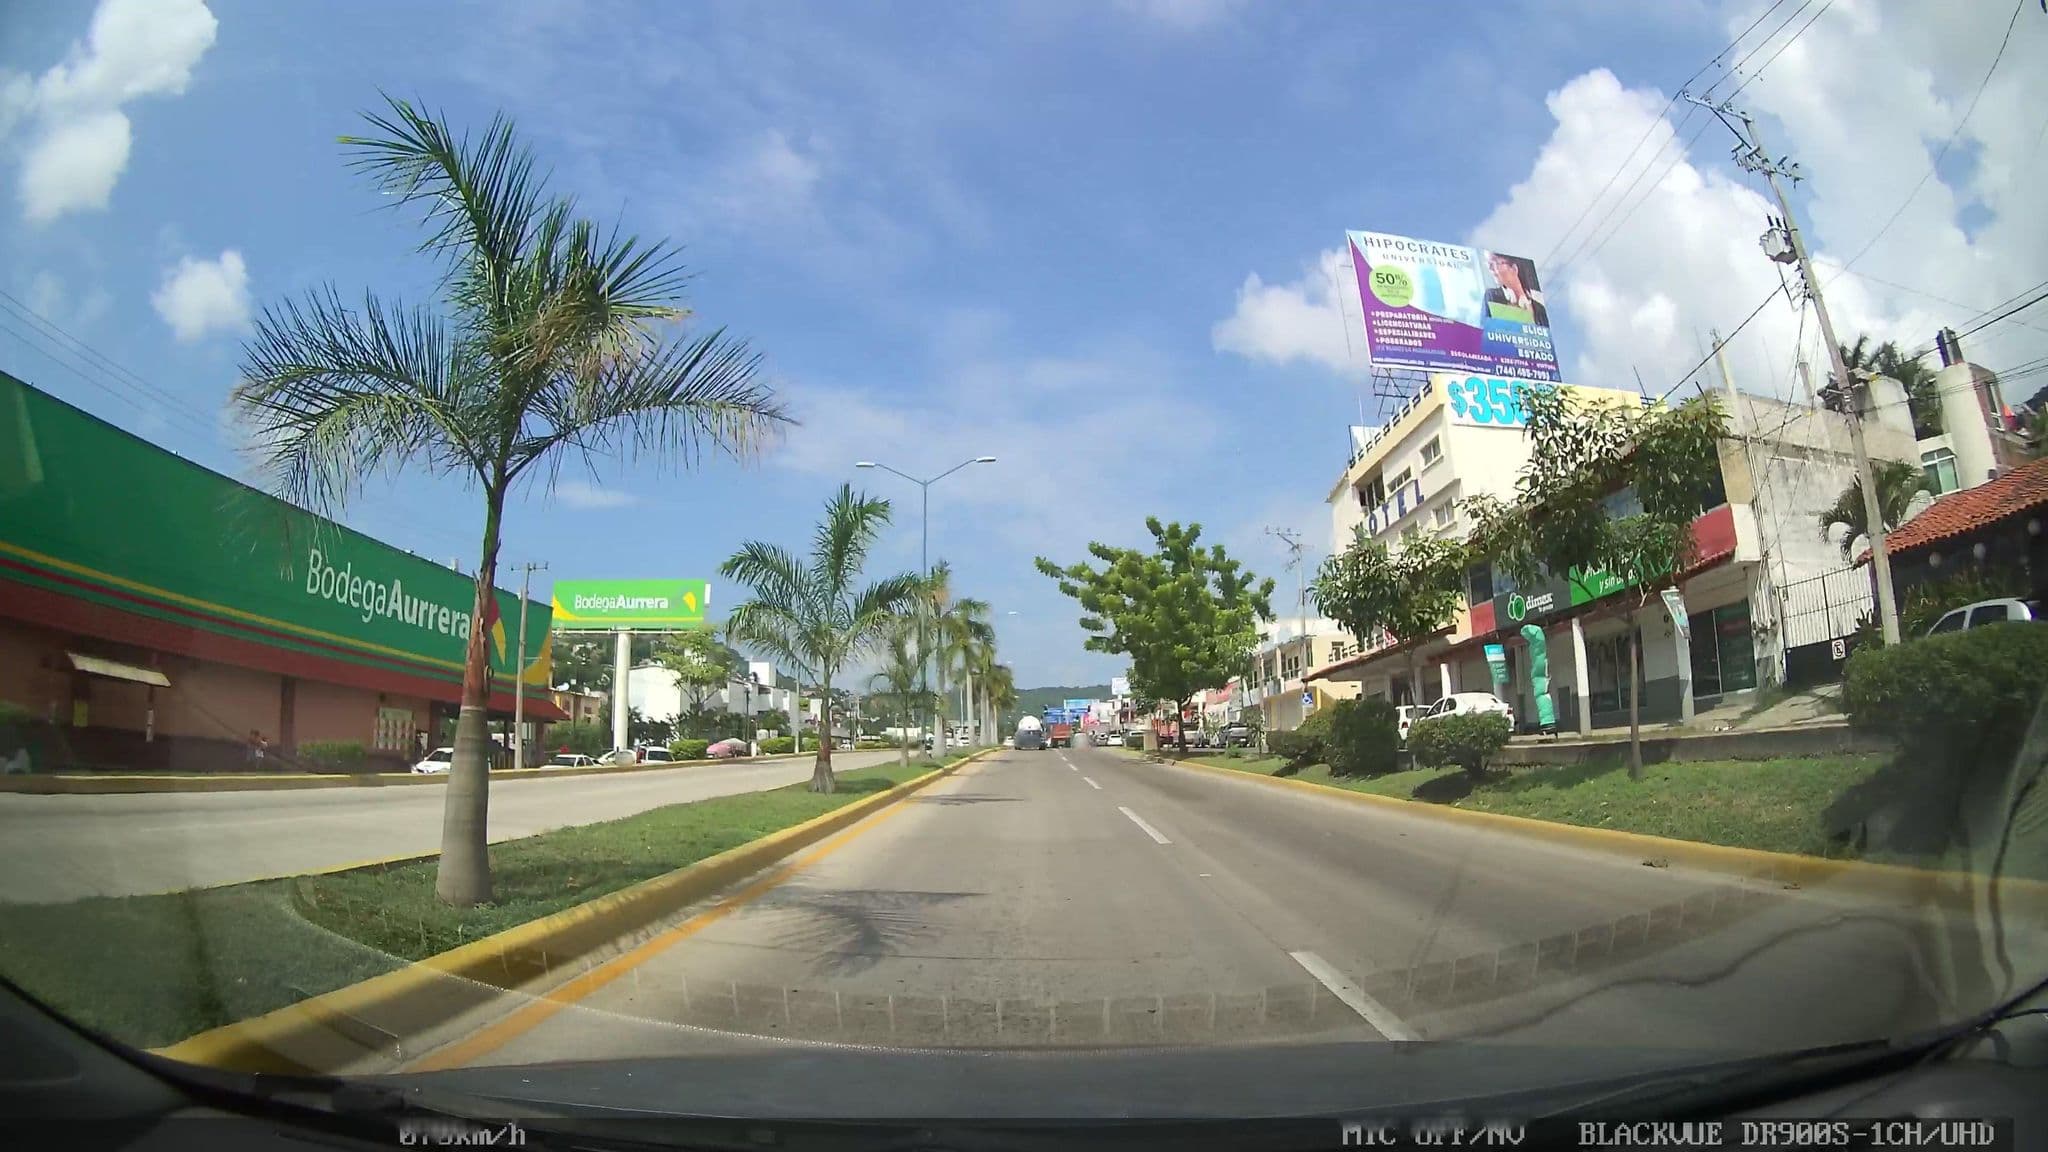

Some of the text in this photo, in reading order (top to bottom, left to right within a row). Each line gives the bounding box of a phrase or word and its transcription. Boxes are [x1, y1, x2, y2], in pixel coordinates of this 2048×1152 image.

[1363, 236, 1470, 261] HIPOCRATES
[1376, 272, 1408, 286] 50%
[1487, 331, 1552, 349] UNIVERSIDAD
[1517, 348, 1554, 362] ESTADO
[1368, 479, 1425, 537] OTEL
